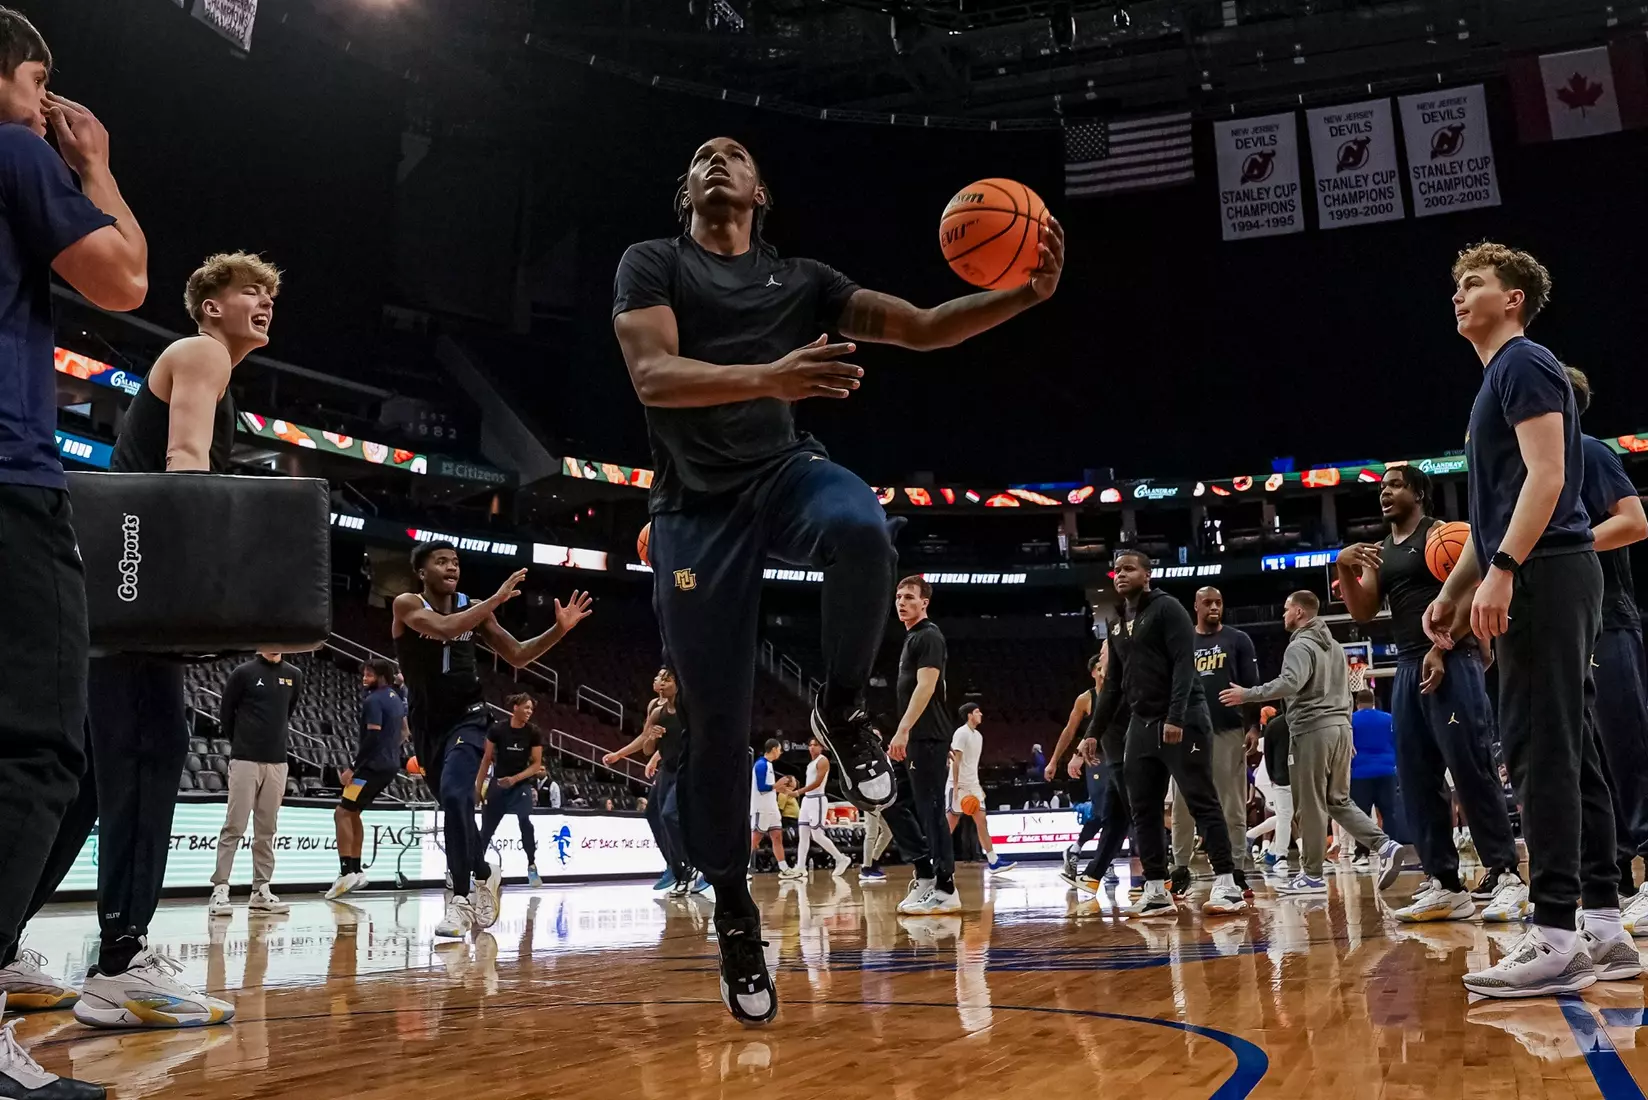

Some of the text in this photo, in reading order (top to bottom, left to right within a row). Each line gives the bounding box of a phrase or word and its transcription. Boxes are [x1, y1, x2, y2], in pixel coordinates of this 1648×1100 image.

[1417, 96, 1468, 111] NEW JERSEY
[1323, 109, 1374, 124] NEW JERSEY
[1422, 107, 1466, 125] DEVILS
[1231, 124, 1279, 137] NEW JERSEY
[1329, 120, 1373, 138] DEVILS
[1235, 134, 1278, 150] DEVILS
[1413, 156, 1491, 180] STANLEY CUP
[1318, 170, 1396, 193] STANLEY CUP
[1418, 173, 1491, 196] CHAMPIONS
[1221, 182, 1298, 205] STANLEY CUP
[1323, 186, 1395, 208] CHAMPIONS
[1424, 189, 1490, 209] 2002-2003
[1226, 200, 1296, 220] CHAMPIONS
[1328, 203, 1394, 221] 1999-2000
[1231, 215, 1295, 232] 1994-1995
[455, 463, 506, 484] Citizens
[339, 514, 365, 530] HOUR
[460, 538, 490, 552] EVERY
[491, 542, 518, 556] HOUR
[118, 515, 141, 602] GoSports
[673, 567, 697, 591] MU
[777, 569, 806, 581] BREAD
[941, 573, 970, 583] BREAD
[970, 573, 1001, 584] EVERY
[1001, 573, 1027, 584] HOUR
[1165, 566, 1195, 578] EVERY
[1197, 564, 1222, 576] HOUR
[168, 835, 218, 850] ET BAC
[273, 836, 292, 850] IFE
[296, 837, 321, 850] YOU
[362, 824, 423, 869] JAG
[581, 837, 598, 849] GET
